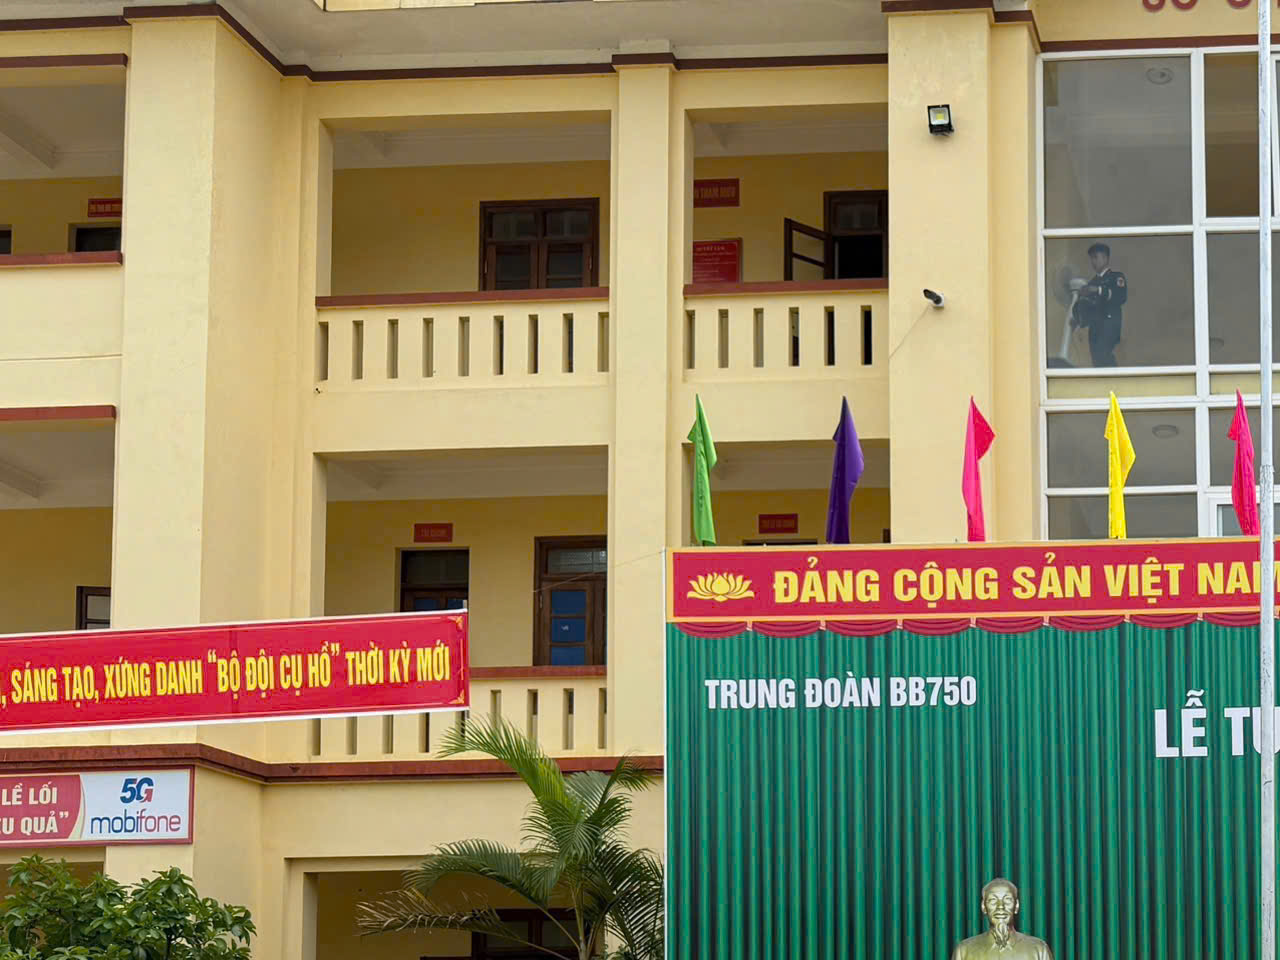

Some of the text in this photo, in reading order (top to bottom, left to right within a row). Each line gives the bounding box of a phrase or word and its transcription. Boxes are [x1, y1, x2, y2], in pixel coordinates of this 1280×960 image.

[773, 557, 879, 603] ĐẢNG
[894, 562, 998, 608] CỘNG
[1013, 552, 1091, 599] SẢN
[1104, 557, 1184, 603] VIỆT
[12, 663, 57, 703] SÁNG
[62, 666, 98, 707] TẠO,
[104, 657, 150, 698] XỨNG
[156, 660, 202, 695] DANH
[246, 649, 274, 697] ĐỘI
[280, 655, 302, 696] CỤ
[346, 642, 383, 685] THỜI
[389, 642, 410, 682] KỲ
[417, 640, 450, 681] MỚI
[705, 672, 976, 708] TRUNG ĐOÀN BB750
[1155, 690, 1207, 757] LỄ
[29, 781, 57, 805] LỐI
[120, 777, 154, 804] 5G
[91, 808, 181, 834] mobifone
